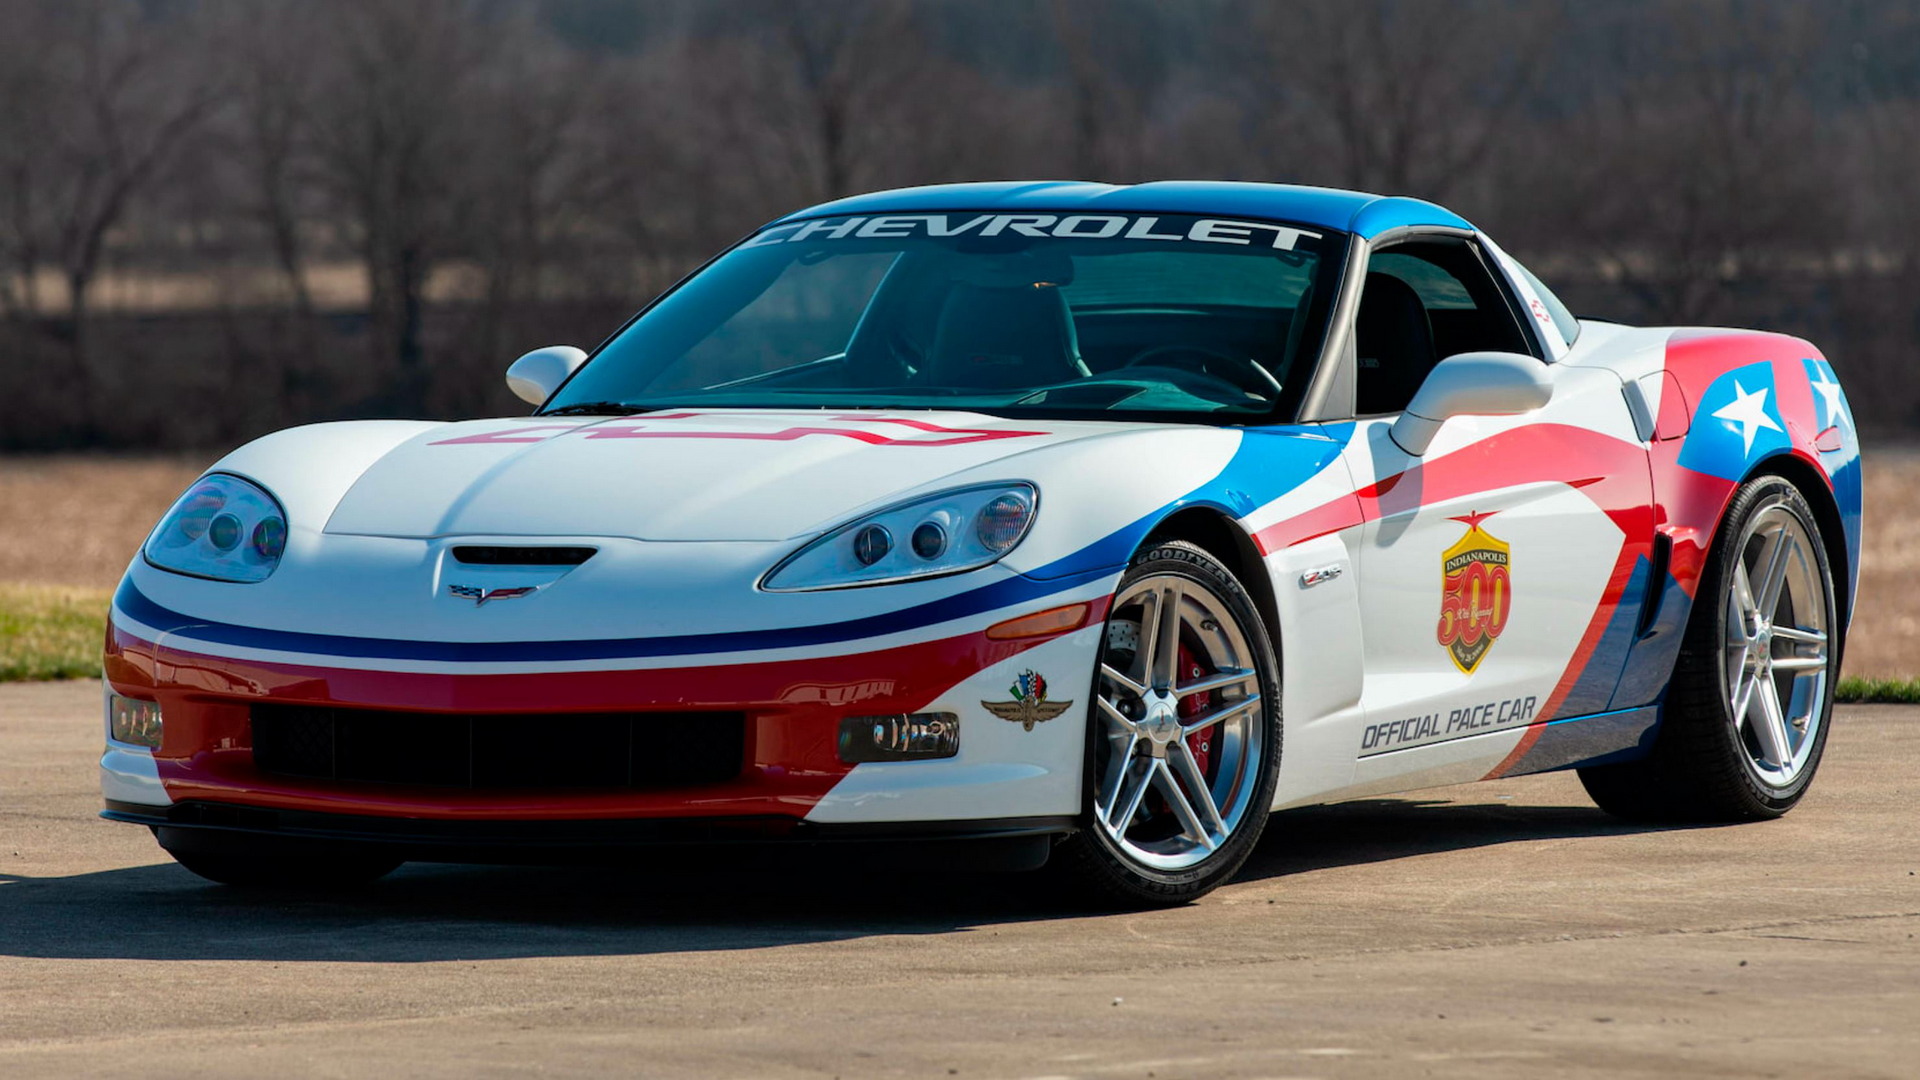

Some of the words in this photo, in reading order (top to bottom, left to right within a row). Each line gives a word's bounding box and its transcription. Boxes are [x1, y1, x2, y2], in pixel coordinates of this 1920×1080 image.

[741, 214, 1322, 251] CHEVROLET
[1446, 551, 1507, 571] INDIANAPOLIS
[1437, 561, 1511, 646] 500
[1361, 713, 1440, 749] OFFICIAL
[1445, 703, 1496, 733] PACE
[1497, 696, 1537, 723] CAR
